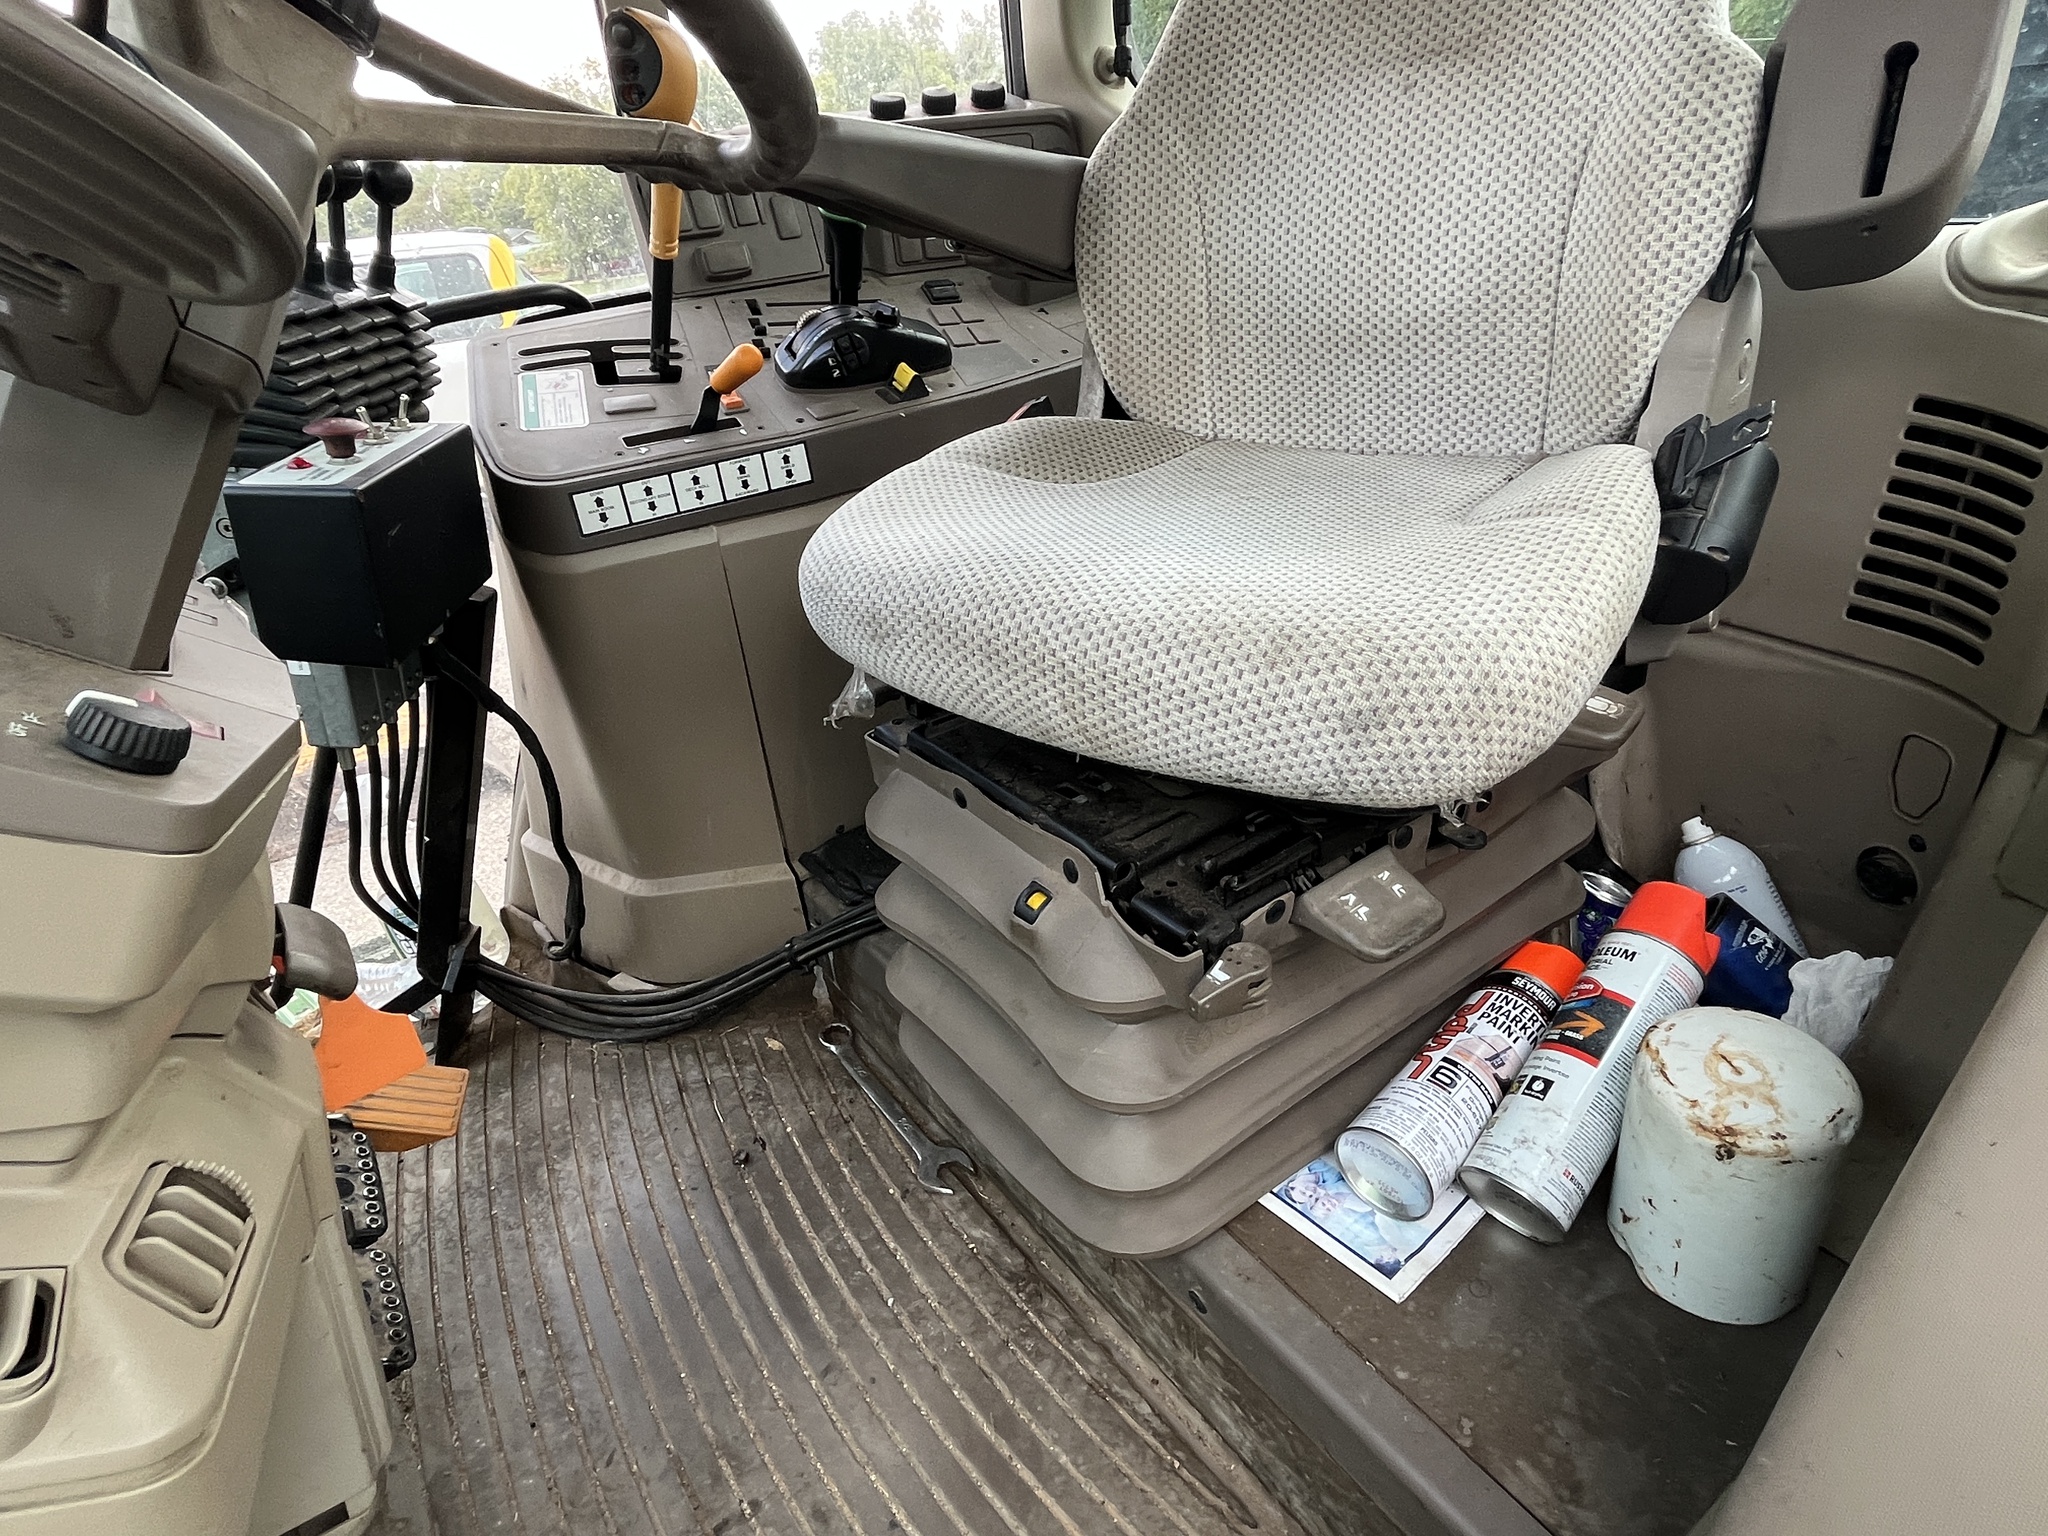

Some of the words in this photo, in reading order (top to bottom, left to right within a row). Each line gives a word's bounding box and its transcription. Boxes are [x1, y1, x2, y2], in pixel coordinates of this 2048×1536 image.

[1511, 976, 1557, 1011] SEYMOUR
[1477, 1012, 1520, 1044] PAINT
[1430, 1065, 1461, 1089] 6
[1457, 1064, 1481, 1086] WATER
[1380, 1125, 1404, 1141] WEIGHT
